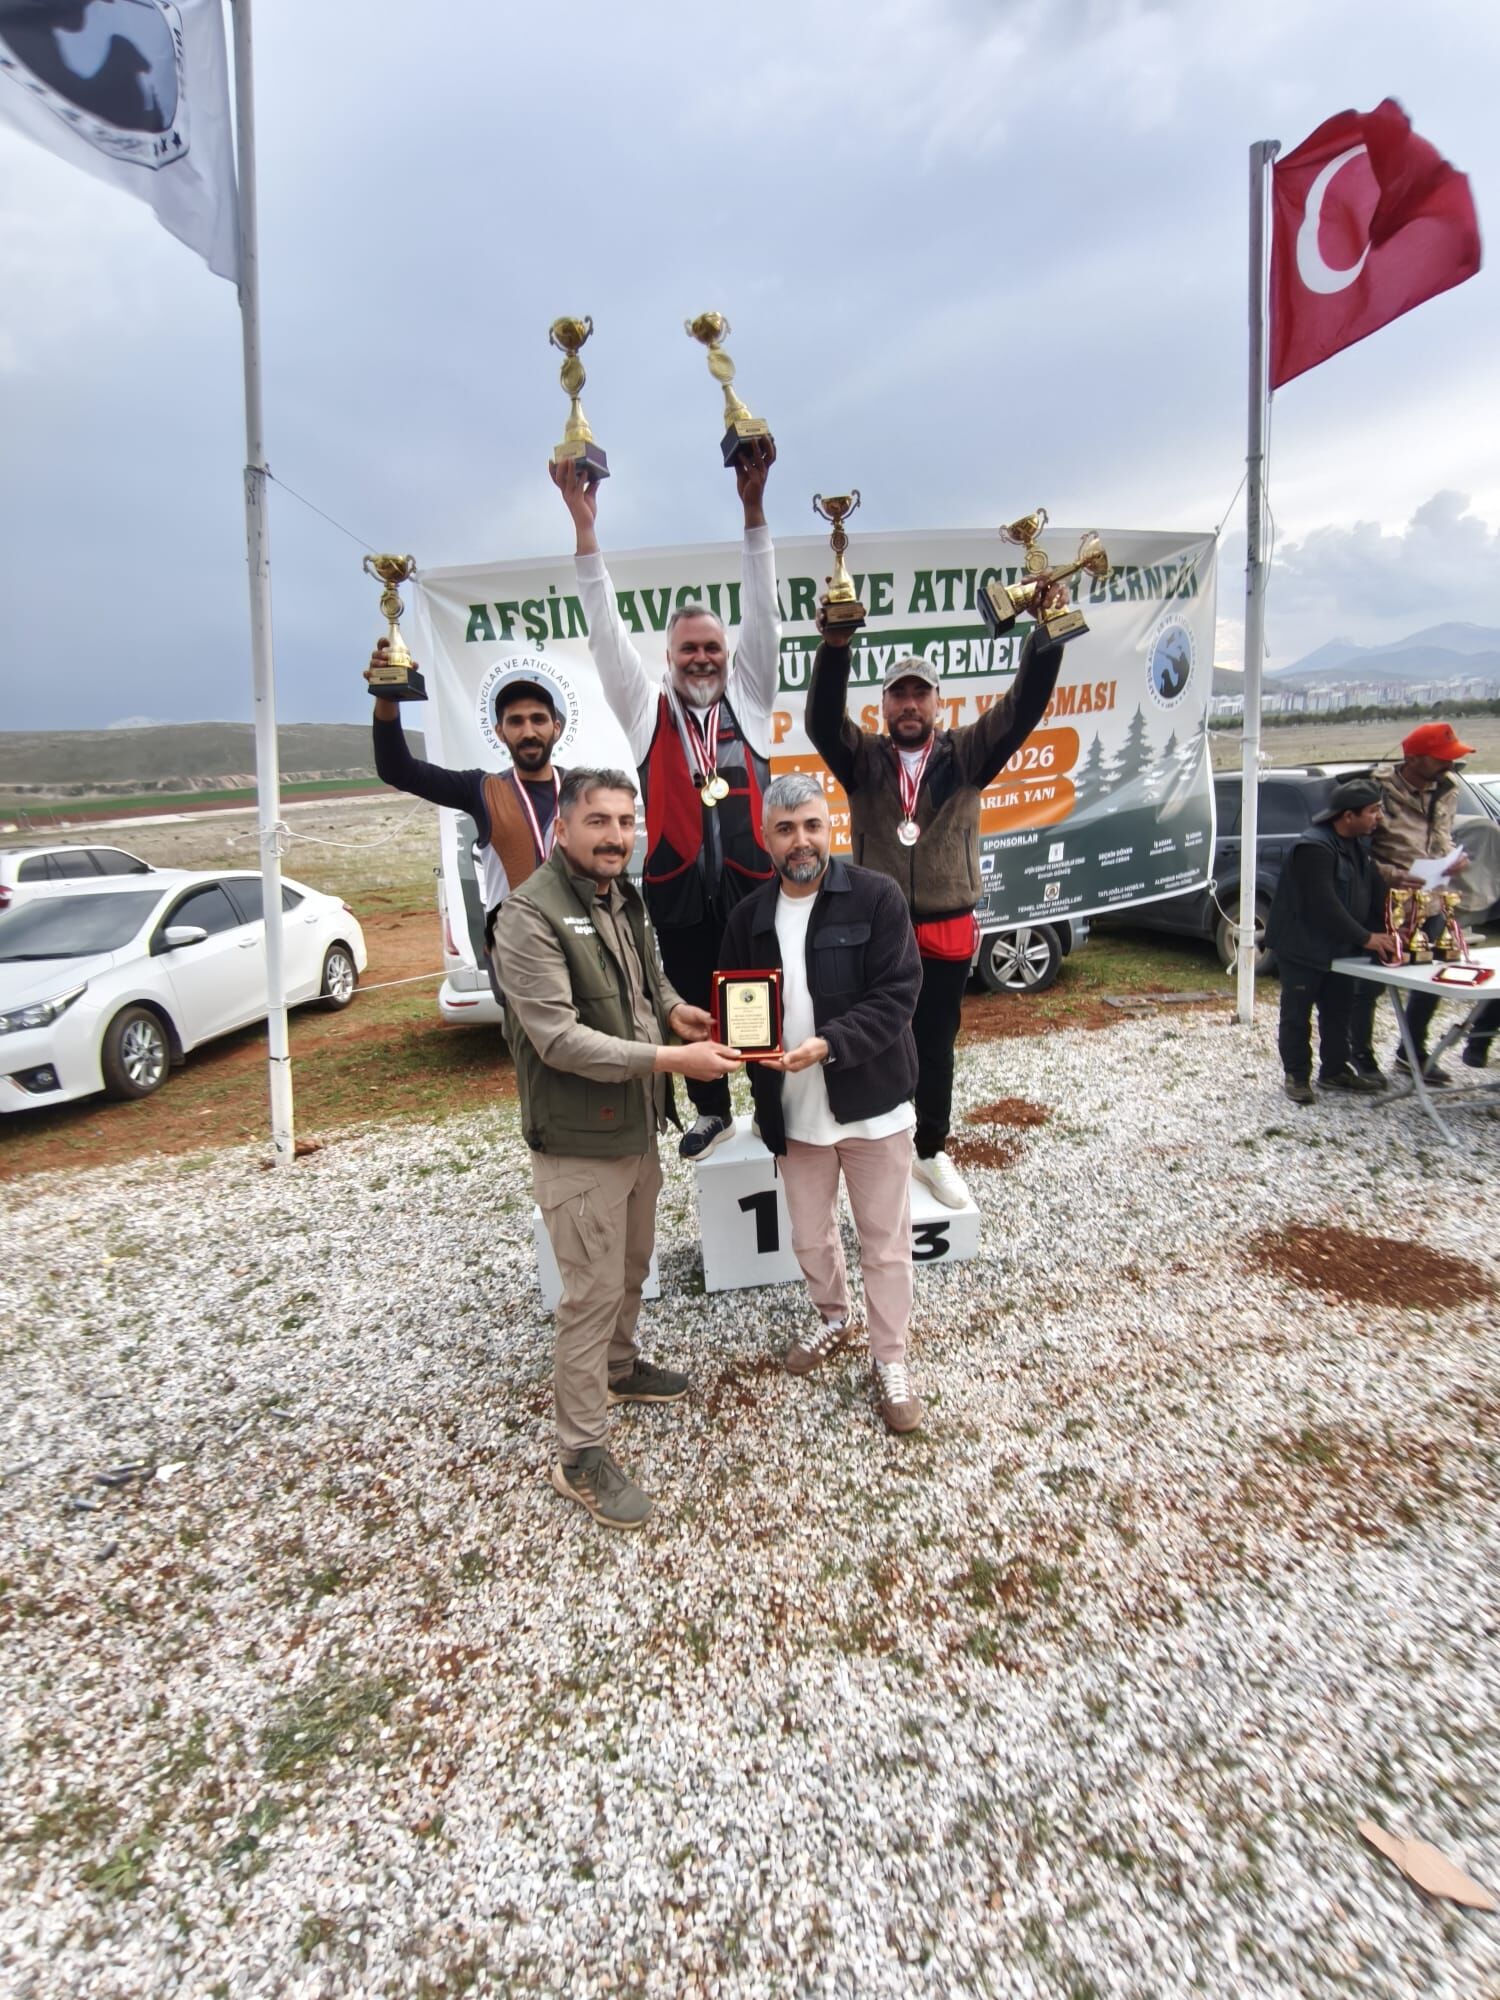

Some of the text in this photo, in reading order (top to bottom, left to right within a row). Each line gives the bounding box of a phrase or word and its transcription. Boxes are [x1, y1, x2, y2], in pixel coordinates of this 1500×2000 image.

[466, 585, 589, 652] AFŞİN
[503, 658, 519, 670] VE
[922, 621, 1036, 678] GENEL
[999, 744, 1056, 775] 026
[983, 833, 1039, 851] SPONSORLAR
[737, 1190, 780, 1254] 1
[911, 1221, 951, 1261] 3
